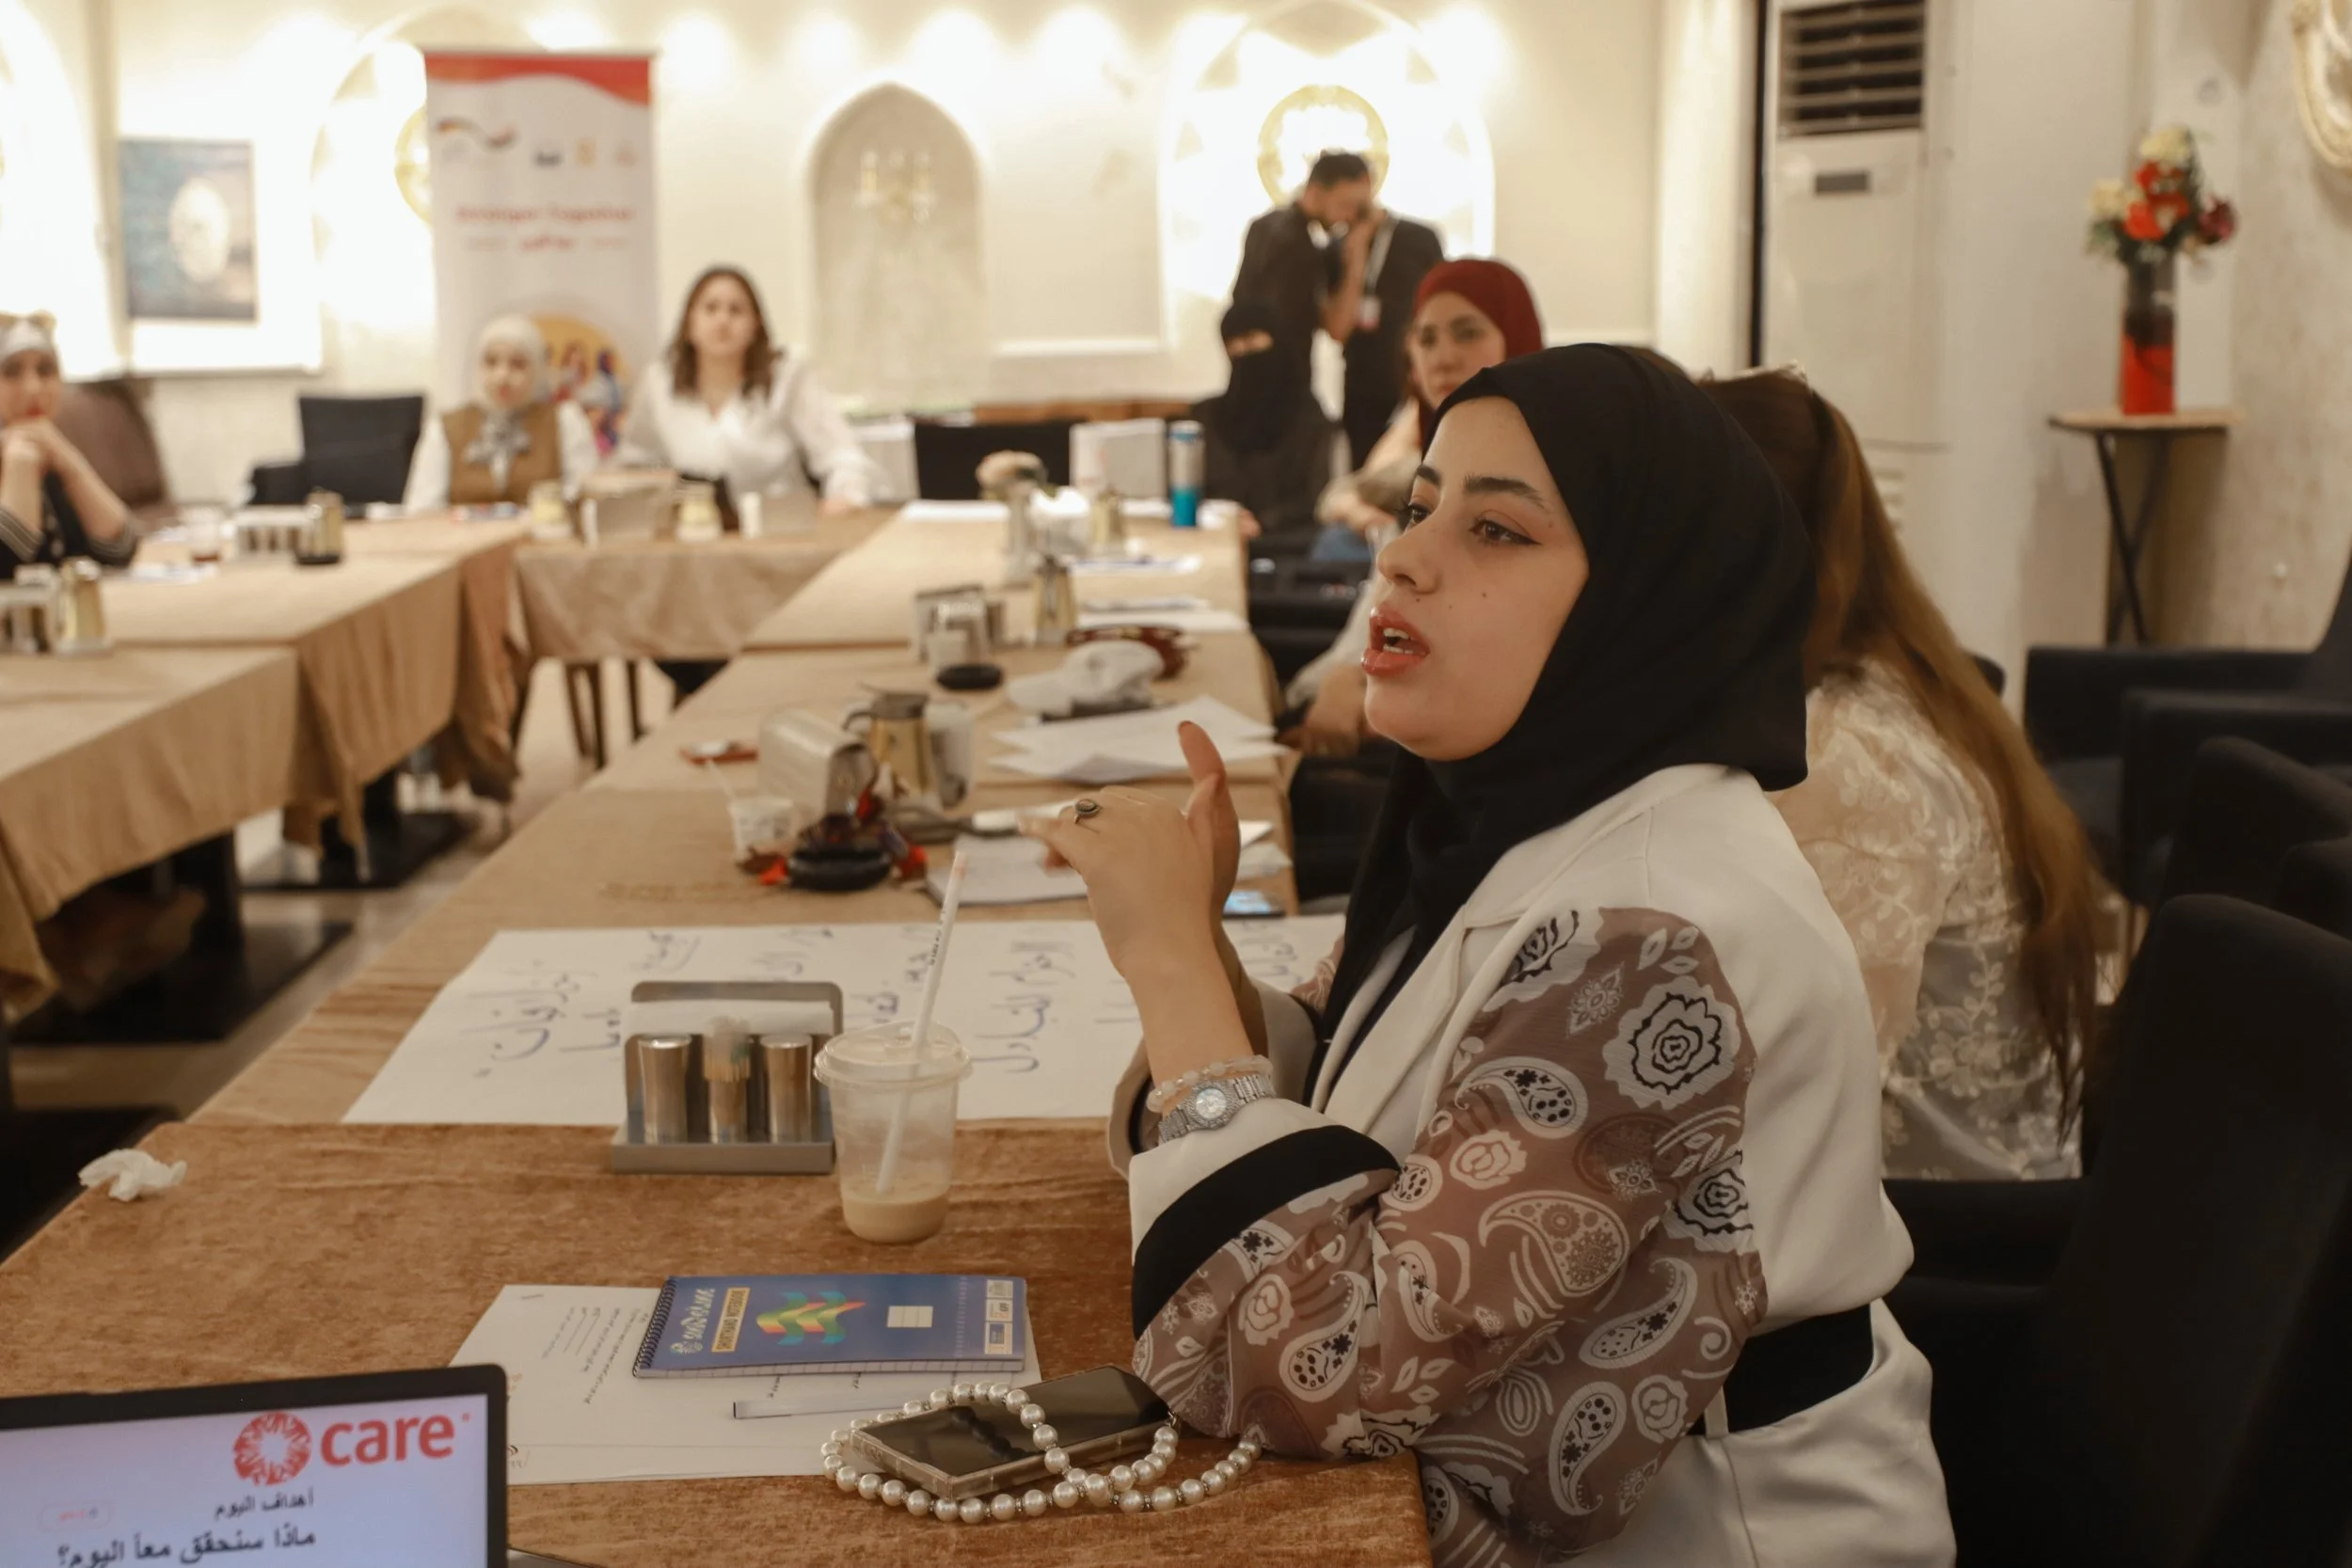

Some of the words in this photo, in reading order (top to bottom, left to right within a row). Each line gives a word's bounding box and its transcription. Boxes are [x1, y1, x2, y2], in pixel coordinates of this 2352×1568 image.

[321, 1414, 455, 1466] care
[214, 1495, 255, 1521] اليوم
[274, 1522, 316, 1547] ماذا
